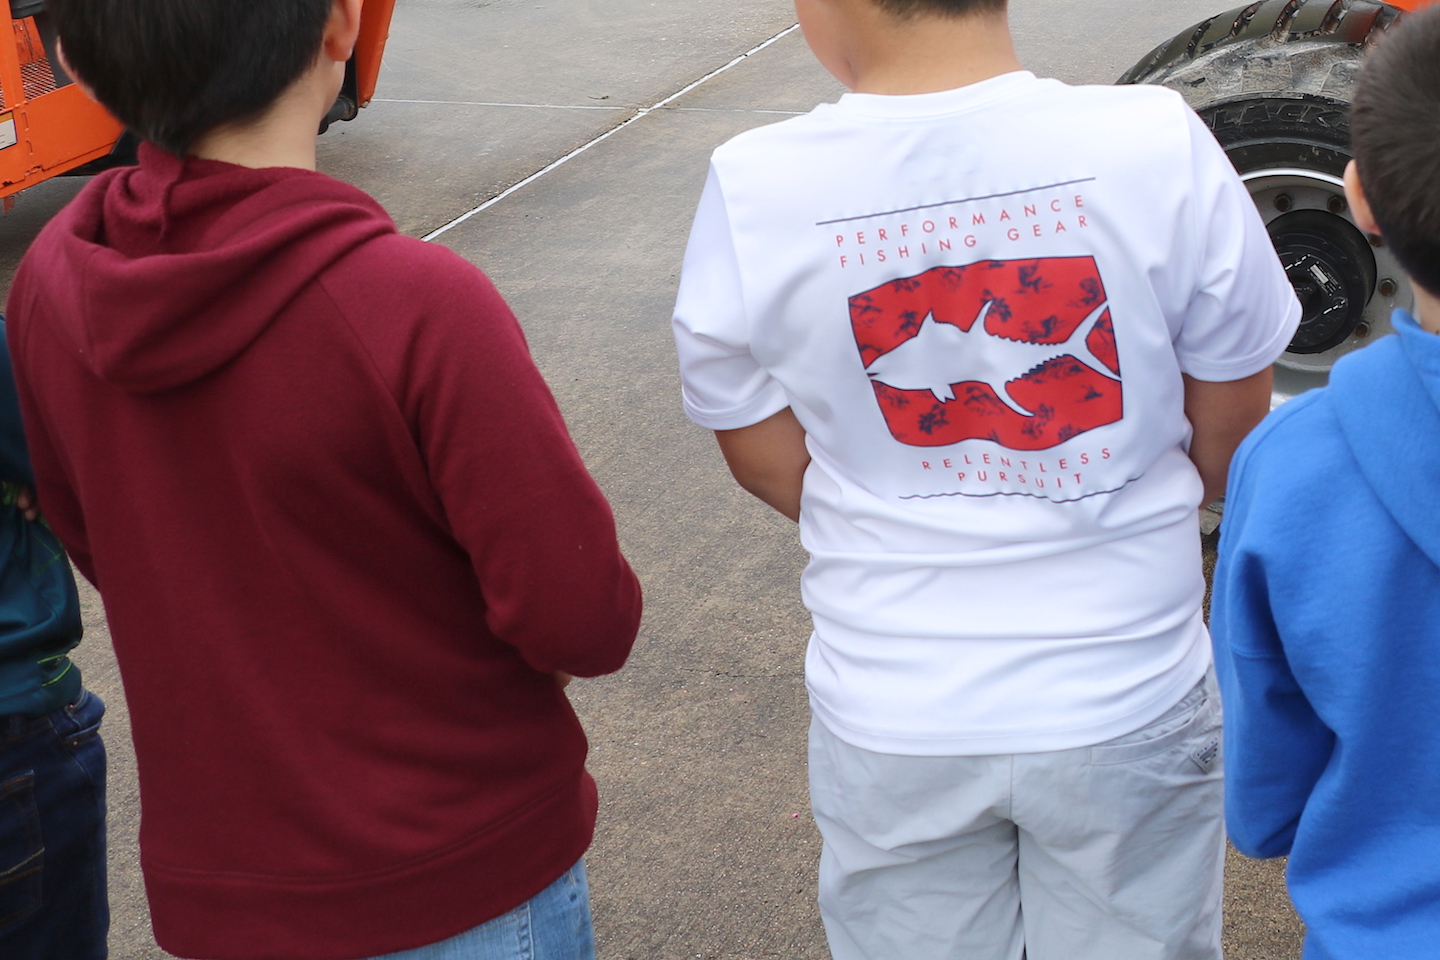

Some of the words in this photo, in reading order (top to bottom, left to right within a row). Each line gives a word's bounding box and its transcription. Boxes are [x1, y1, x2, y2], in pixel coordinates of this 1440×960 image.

[836, 195, 1084, 247] PERFORMANCE
[840, 235, 977, 268] FISHING
[1007, 216, 1088, 241] GEAR
[922, 448, 1110, 473] RELENTLESS
[958, 472, 1082, 489] PURSUIT
